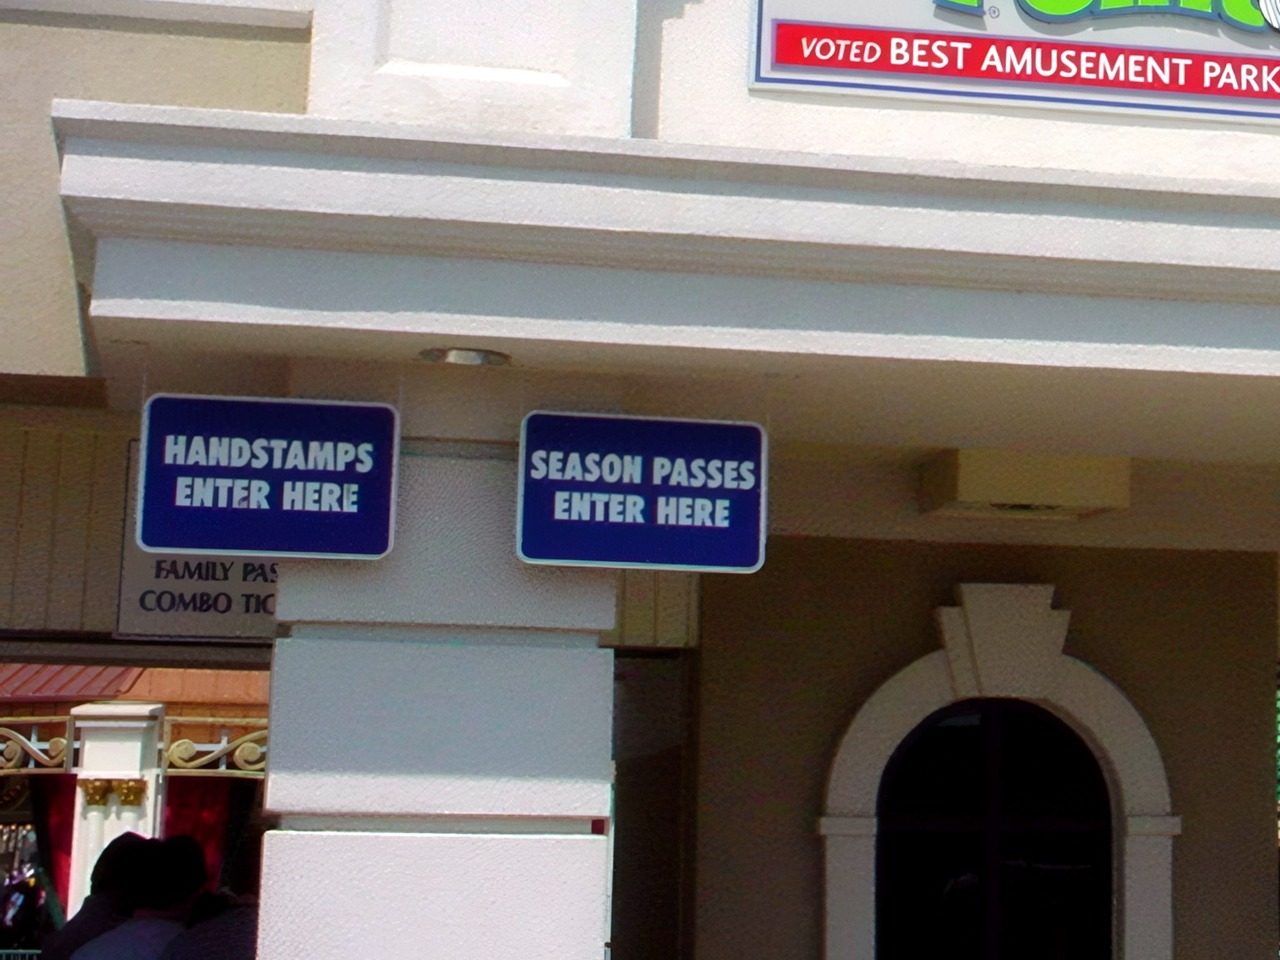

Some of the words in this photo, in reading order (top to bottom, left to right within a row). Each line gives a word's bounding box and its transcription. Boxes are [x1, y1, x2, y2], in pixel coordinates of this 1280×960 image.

[801, 37, 882, 63] VOTED
[890, 37, 972, 69] BEST
[980, 44, 1193, 86] AMUSEMENT
[164, 435, 374, 473] HANDSTAMPS
[530, 450, 643, 484] SEASON
[652, 457, 756, 490] PASSES
[175, 476, 270, 509] ENTER
[282, 481, 359, 513] HERE
[554, 491, 645, 523] ENTER
[657, 496, 730, 528] HERE
[154, 560, 235, 581] FAMILY
[139, 590, 233, 614] COMBO
